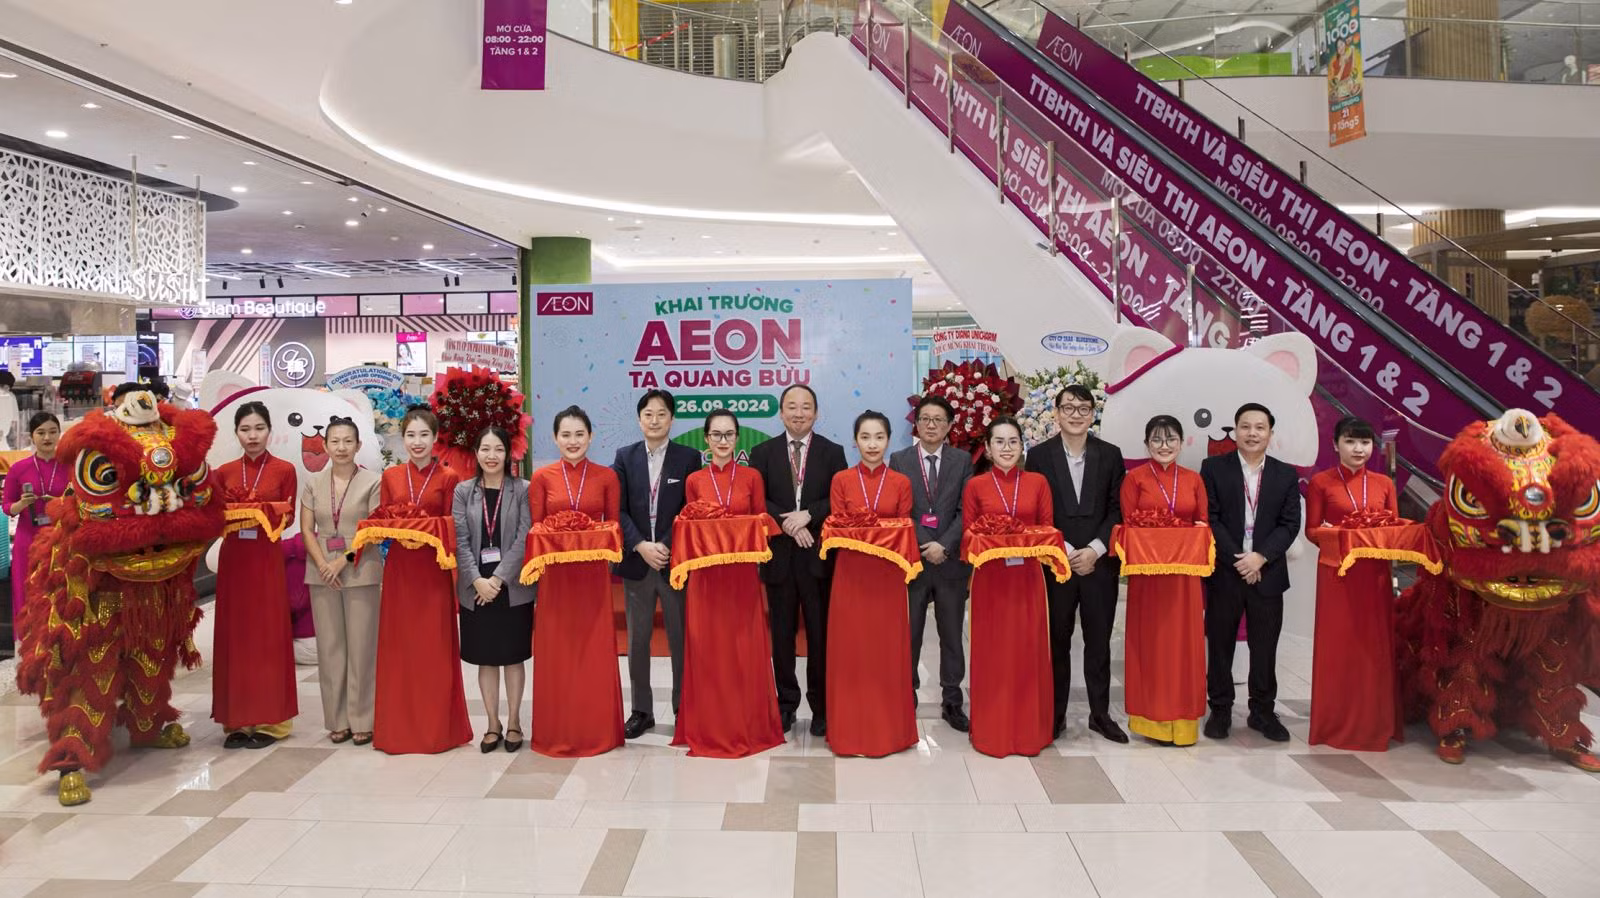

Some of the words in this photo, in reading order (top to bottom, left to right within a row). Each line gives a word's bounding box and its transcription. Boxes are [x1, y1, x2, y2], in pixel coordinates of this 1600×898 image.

[1029, 73, 1090, 138] TTBHTH
[1088, 115, 1115, 160] VÀ
[1116, 147, 1163, 194] SIÊU
[1163, 181, 1200, 232] THỊ
[1196, 214, 1267, 281] AEON
[1280, 277, 1355, 352] TẦNG
[1357, 344, 1378, 372] 1
[1376, 361, 1401, 395] &
[1401, 382, 1430, 417] 2
[1134, 82, 1201, 146] TTBHTH
[1202, 130, 1228, 167] VÀ
[1228, 152, 1278, 199] SIÊU
[1277, 188, 1318, 236] THỊ
[1315, 219, 1390, 282] AEON
[1405, 278, 1483, 349] TẦNG
[1487, 341, 1508, 368] 1
[1505, 357, 1532, 389] &
[1532, 376, 1563, 409] 2
[1158, 221, 1202, 265] 08:00
[1099, 262, 1144, 315] 2:00
[1275, 223, 1321, 264] 08:00
[1334, 266, 1385, 313] 22:00
[200, 300, 240, 315] Glam
[244, 300, 327, 317] Beautique
[654, 296, 703, 316] KHAI
[708, 292, 794, 314] TRƯƠNG
[633, 318, 803, 364] AEON
[331, 367, 391, 385] CONGRATULATIONS
[664, 370, 752, 388] QUANG
[758, 364, 811, 387] BỬU
[677, 399, 770, 413] 26.092024
